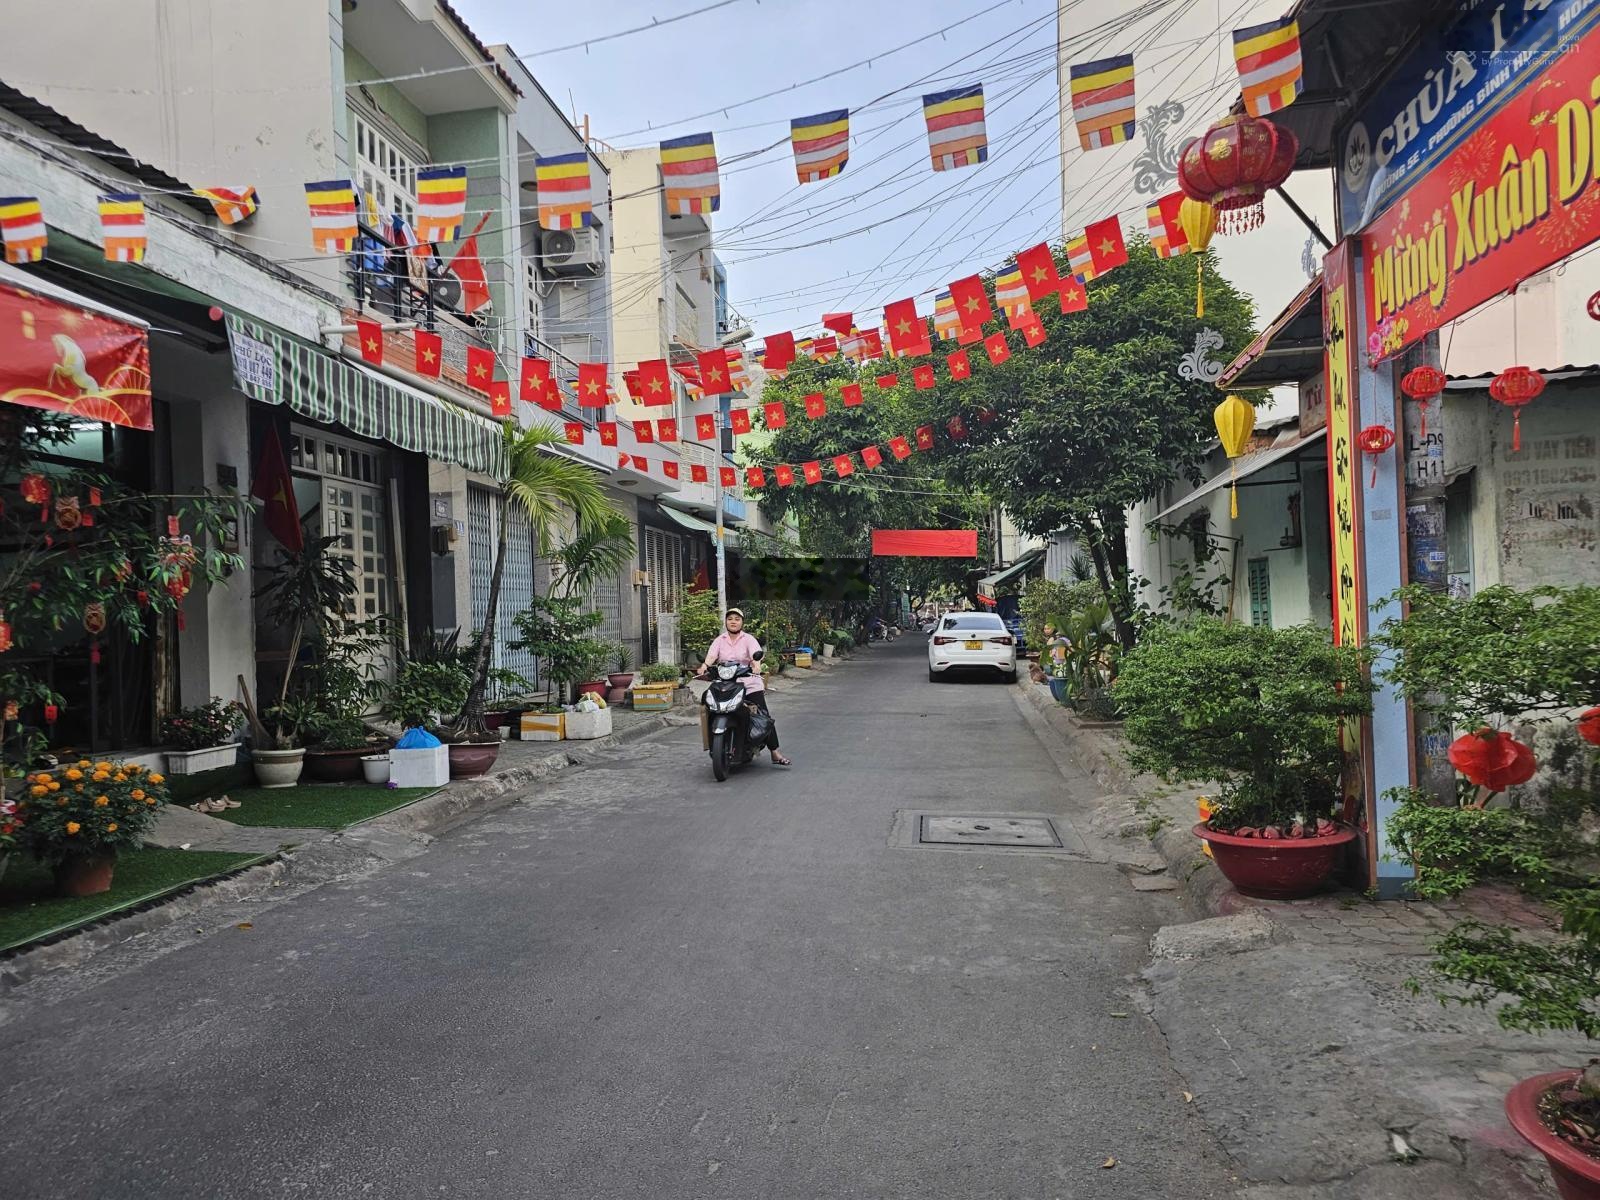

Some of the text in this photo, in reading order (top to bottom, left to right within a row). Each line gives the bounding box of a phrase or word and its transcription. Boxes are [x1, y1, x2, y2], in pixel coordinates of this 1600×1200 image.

[1477, 65, 1510, 106] BÌNH
[1373, 224, 1448, 324] Mừng
[1452, 144, 1549, 273] Xuân
